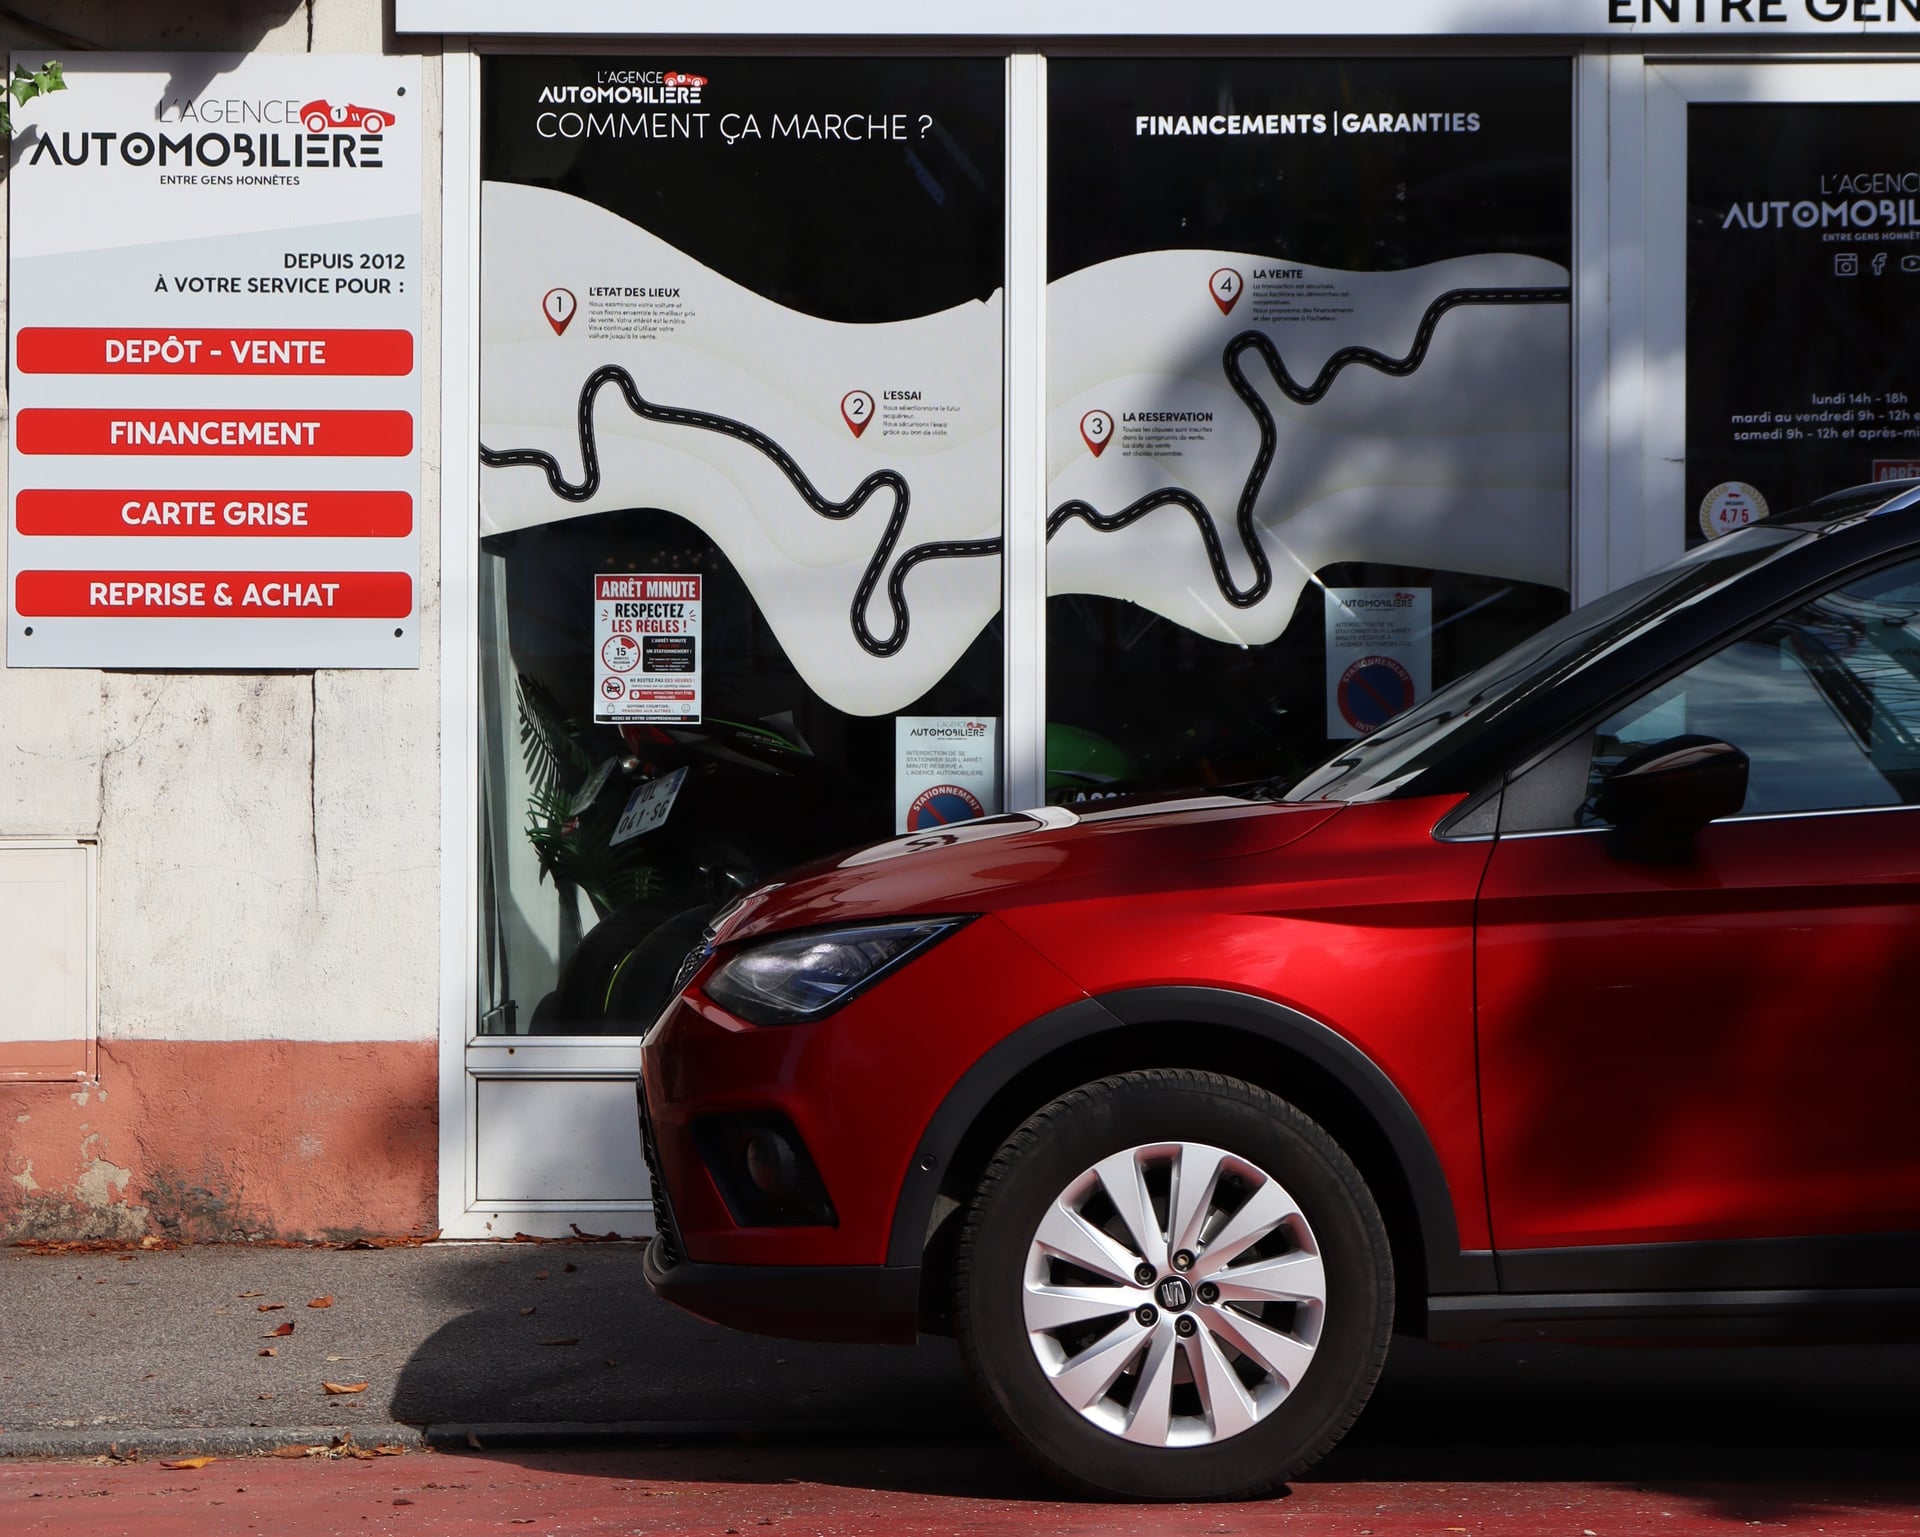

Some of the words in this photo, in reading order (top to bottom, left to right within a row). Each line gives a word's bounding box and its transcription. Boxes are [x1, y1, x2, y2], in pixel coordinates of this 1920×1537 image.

[598, 71, 663, 84] L'AGENCE
[158, 98, 300, 124] L'AGENCE
[336, 108, 341, 119] 1
[537, 112, 710, 138] COMMENT
[720, 113, 761, 145] ÇA
[771, 114, 907, 140] MARCHE
[1136, 115, 1327, 135] FINANCEMENTS
[1342, 112, 1481, 133] GARANTIES
[160, 175, 197, 184] ENTRE
[201, 176, 233, 185] GENS
[237, 175, 300, 185] HONNÊTES
[1722, 199, 1920, 229] AUTOMOBIL
[1822, 233, 1852, 241] ENTRE
[1854, 233, 1879, 241] GENS
[285, 253, 353, 269] DEPUIS
[360, 254, 405, 269] 2012
[1253, 270, 1267, 279] LA
[1269, 270, 1303, 279] VENTE
[155, 274, 168, 292] À
[174, 277, 241, 293] VOTRE
[248, 277, 329, 293] SERVICE
[336, 278, 391, 294] POUR
[1220, 277, 1232, 292] 4
[590, 287, 622, 296] L'ETAT
[625, 288, 646, 297] DES
[649, 288, 680, 297] LIEUX
[557, 296, 561, 312] 1
[106, 336, 202, 363] DEPÔT
[230, 341, 325, 364] VENTE
[884, 391, 921, 400] L'ESSAI
[1812, 393, 1845, 405] lundi
[1849, 393, 1871, 404] 14h
[1885, 392, 1907, 403] 18h
[853, 398, 864, 414] 2
[1123, 412, 1136, 422] LA
[1138, 412, 1213, 422] RESERVATION
[1732, 411, 1771, 423] mardi
[1775, 414, 1792, 422] au
[1795, 410, 1854, 422] vendredi
[1858, 410, 1874, 421] 9h
[1889, 410, 1910, 420] 12h
[111, 421, 320, 445] FINANCEMENT
[1092, 418, 1103, 434] 3
[1734, 428, 1782, 440] samedi
[1786, 428, 1803, 439] 9h
[1817, 427, 1838, 438] 12h
[1842, 428, 1855, 438] et
[122, 502, 215, 525] CARTE
[223, 502, 308, 525] GRISE
[90, 583, 205, 606] REPRISE
[214, 583, 233, 606] &
[242, 583, 339, 606] ACHAT
[602, 578, 642, 598] ARRÊT
[647, 581, 695, 598] MINUTE
[615, 603, 685, 618] RESPECTEZ
[611, 619, 632, 633] LES
[616, 647, 626, 656] 15
[913, 786, 981, 813] STATIONNEMENT
